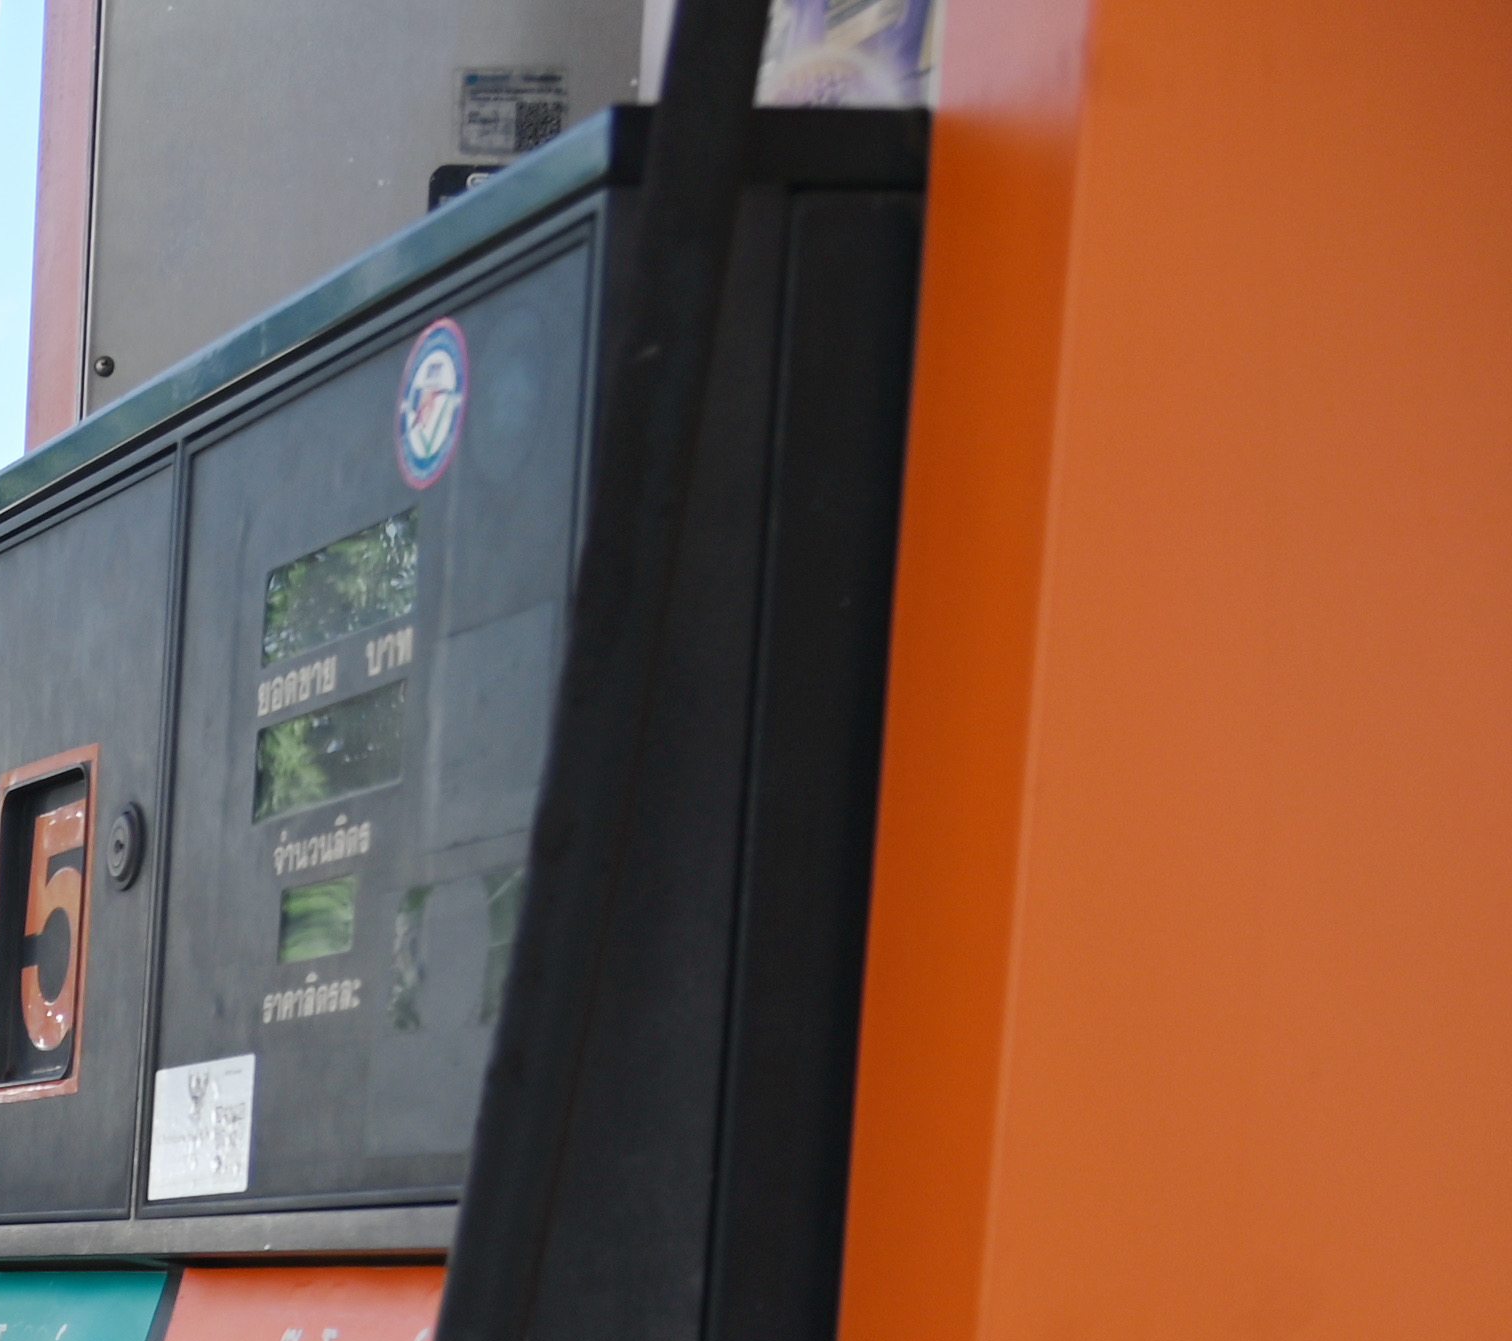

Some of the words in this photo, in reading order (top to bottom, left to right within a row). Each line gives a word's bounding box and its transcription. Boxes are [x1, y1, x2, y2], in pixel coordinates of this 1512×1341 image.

[257, 655, 339, 718] ยอดขาย
[366, 626, 414, 677] บาท
[273, 813, 371, 876] จำนวนลิตร
[20, 799, 86, 1051] 5
[263, 971, 362, 1024] ราคาลิตรละ
